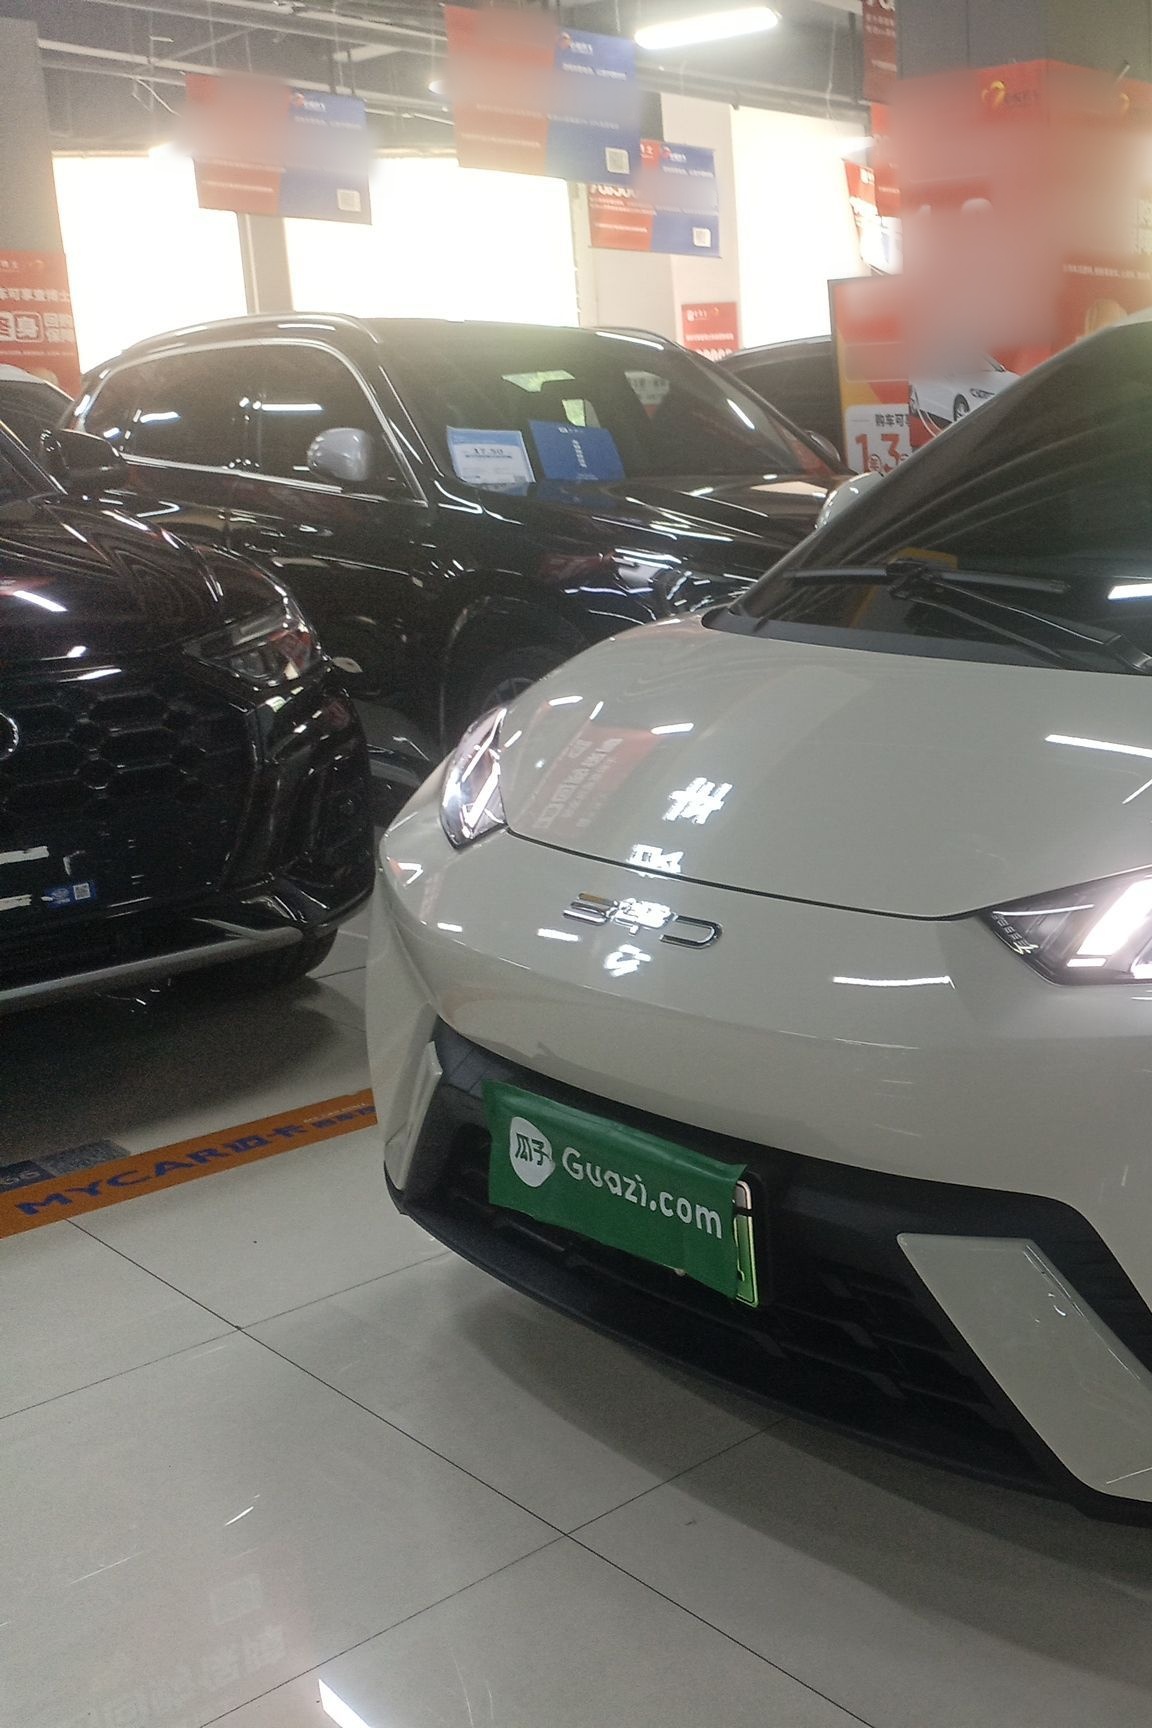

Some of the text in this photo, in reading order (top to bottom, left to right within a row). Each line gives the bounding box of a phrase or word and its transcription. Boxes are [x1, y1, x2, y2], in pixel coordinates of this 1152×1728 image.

[875, 413, 910, 427] 购车可
[515, 1133, 723, 1239] 瓜子 Guazi.com
